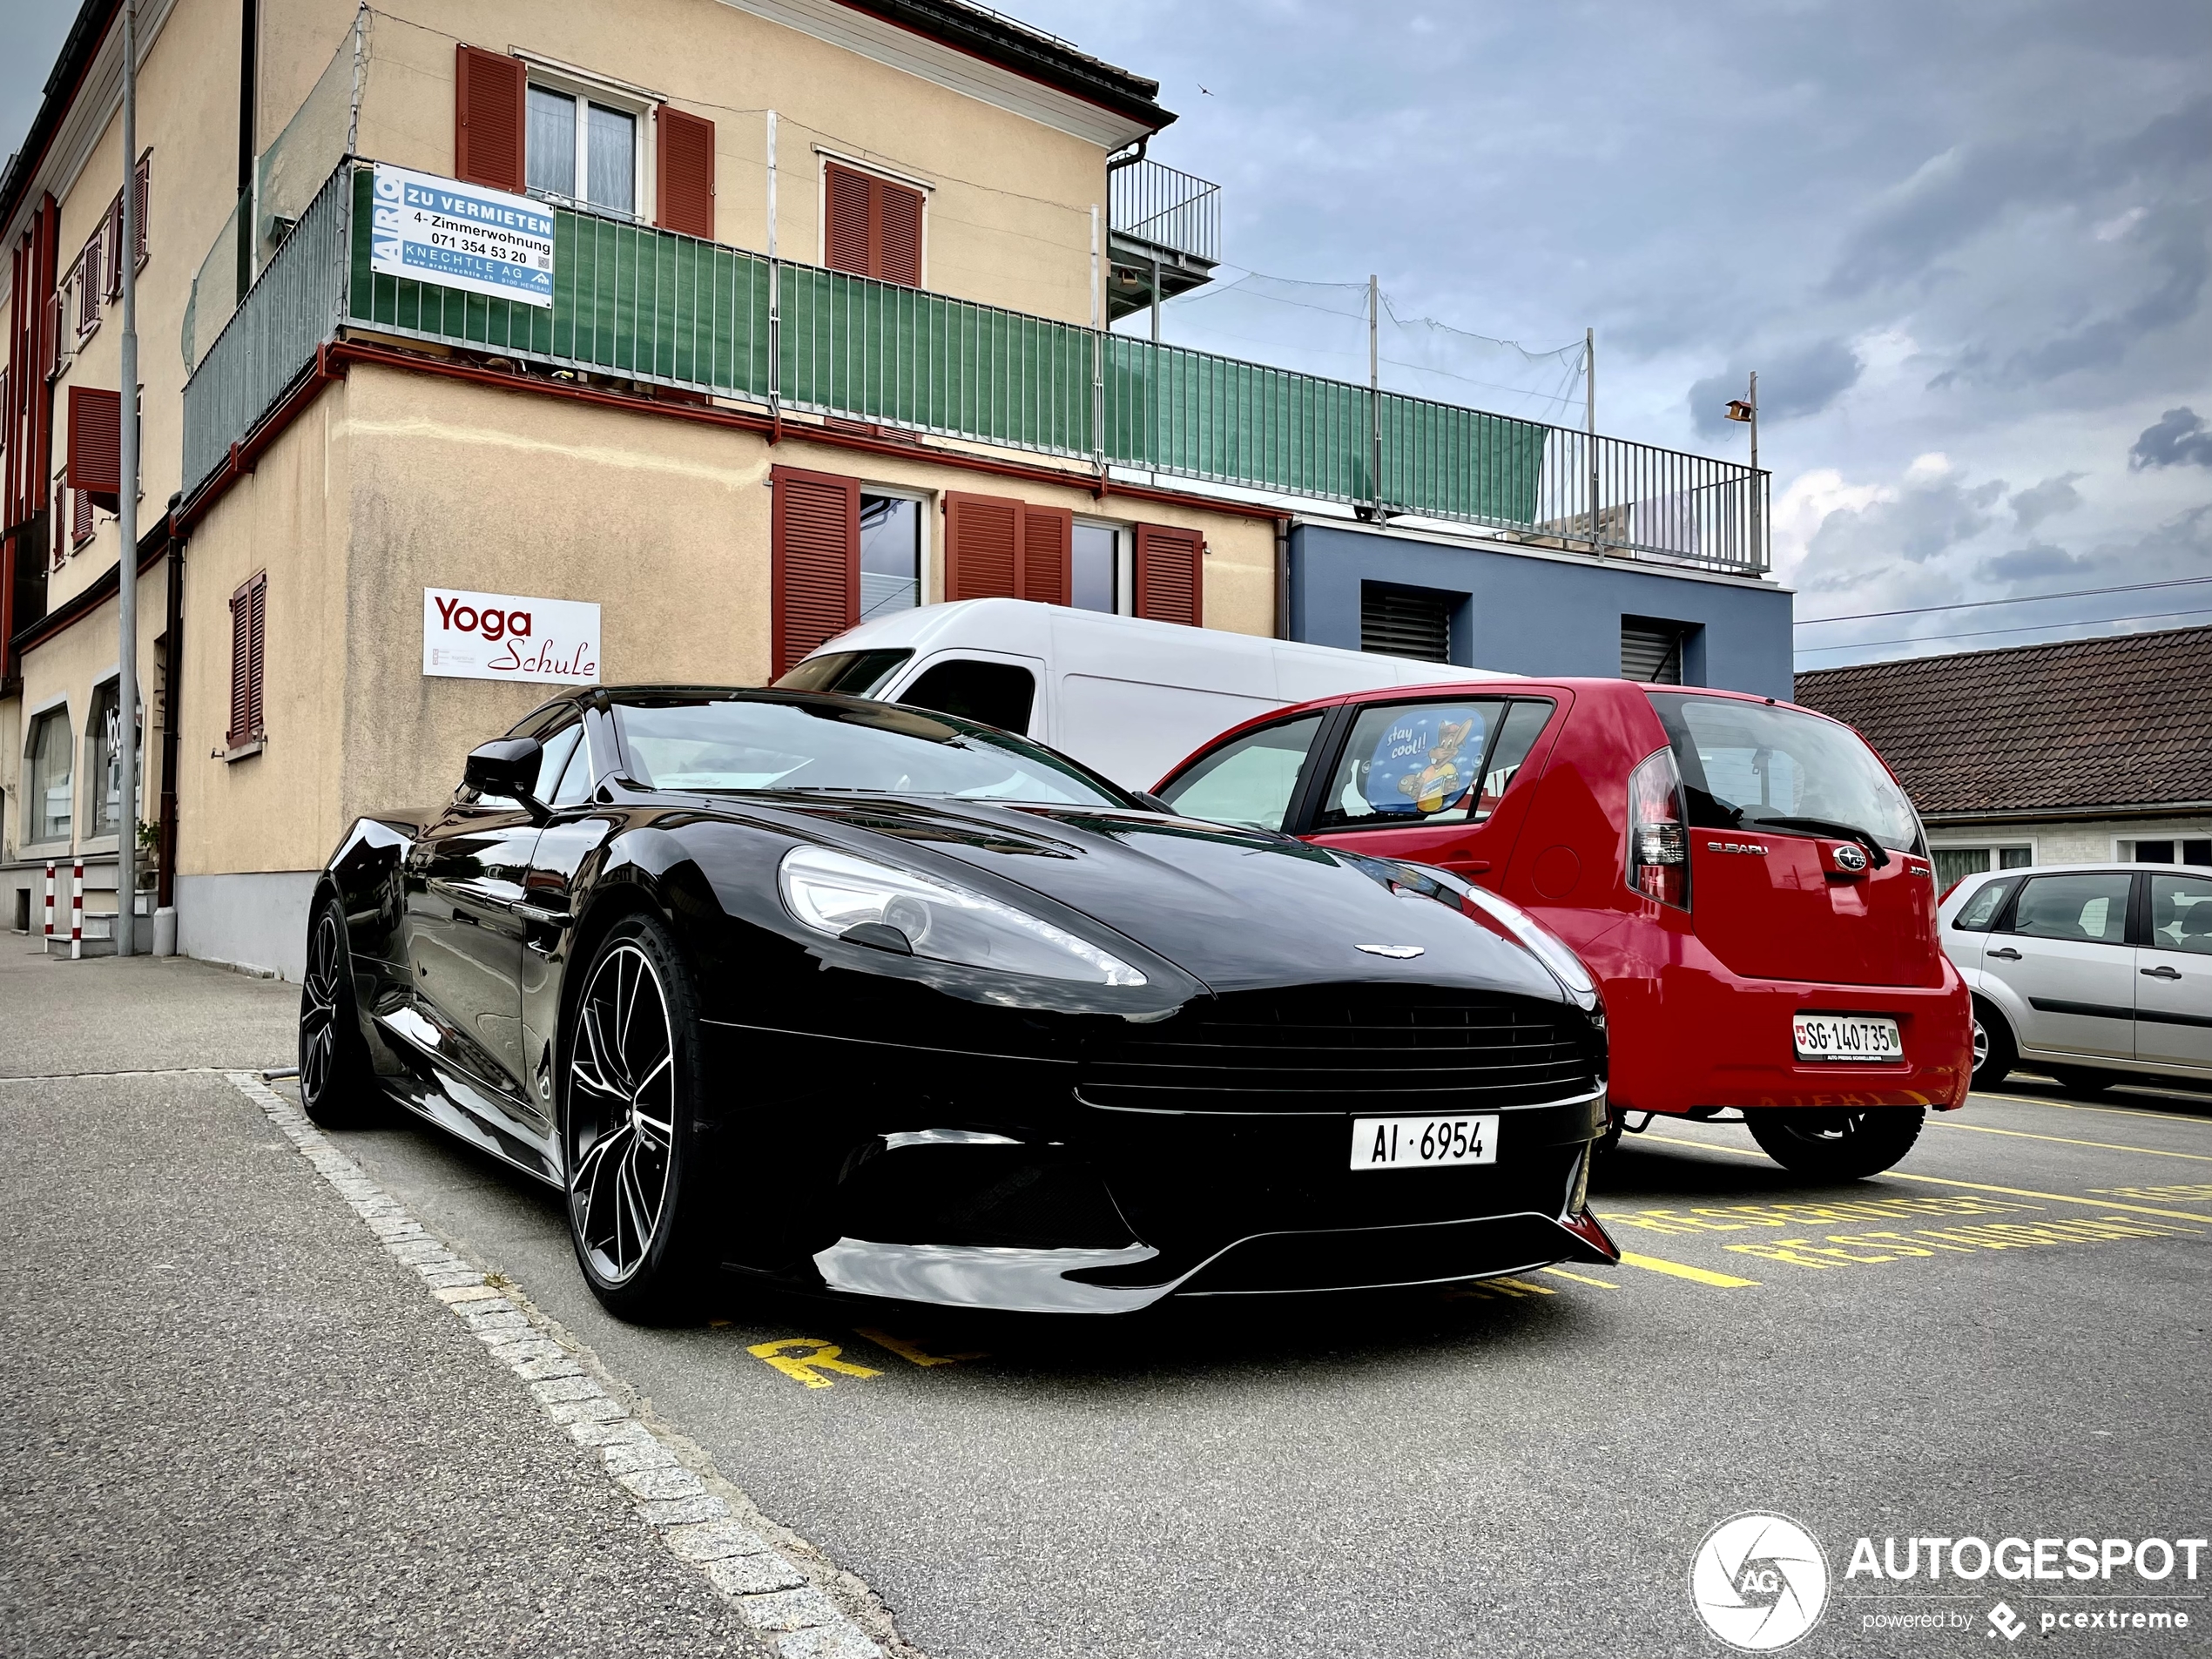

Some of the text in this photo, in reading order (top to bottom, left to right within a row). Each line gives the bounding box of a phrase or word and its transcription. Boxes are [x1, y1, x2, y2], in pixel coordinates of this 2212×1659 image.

[408, 189, 551, 234] ZU VERMIETEN
[431, 215, 550, 255] Zimmerwohnung
[431, 233, 527, 264] 071 354 53 20
[406, 245, 523, 279] KNECHTLE AG
[406, 258, 494, 281] www.aroknechtle.ch
[501, 277, 550, 293] 9100 HERISAU
[434, 597, 532, 642] Yoga
[488, 638, 596, 676] Schule
[1386, 726, 1413, 746] stay
[1391, 732, 1426, 759] cool!!
[1707, 842, 1769, 855] SUBARU
[1595, 1196, 2047, 1234] RESERVIERT
[1721, 1217, 2206, 1269] RESTAURANT
